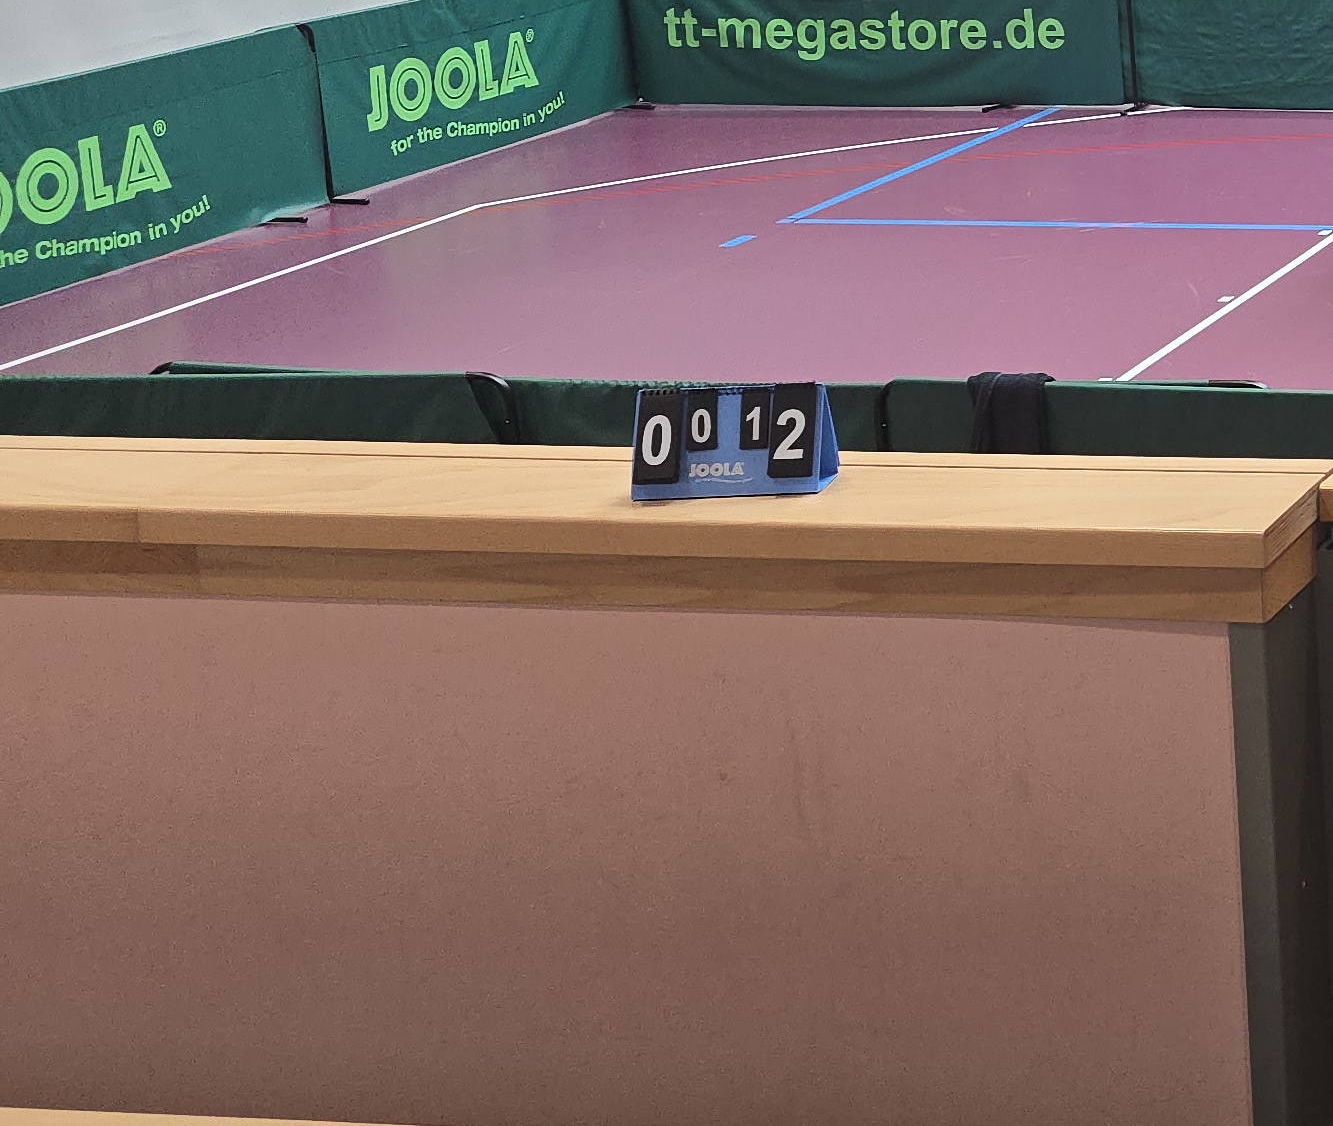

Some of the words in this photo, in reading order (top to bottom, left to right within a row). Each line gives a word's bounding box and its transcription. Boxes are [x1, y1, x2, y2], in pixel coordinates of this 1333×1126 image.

[664, 7, 1066, 61] tt-megastore.de
[390, 133, 413, 156] for
[416, 125, 443, 145] the
[446, 117, 520, 138] Champion
[522, 112, 536, 127] in
[538, 90, 566, 123] you!
[35, 231, 143, 260] Champion
[148, 223, 168, 241] in
[170, 194, 211, 234] you!
[642, 414, 672, 466] 0
[691, 408, 712, 443] 0
[746, 406, 761, 441] 1
[772, 408, 806, 460] 2
